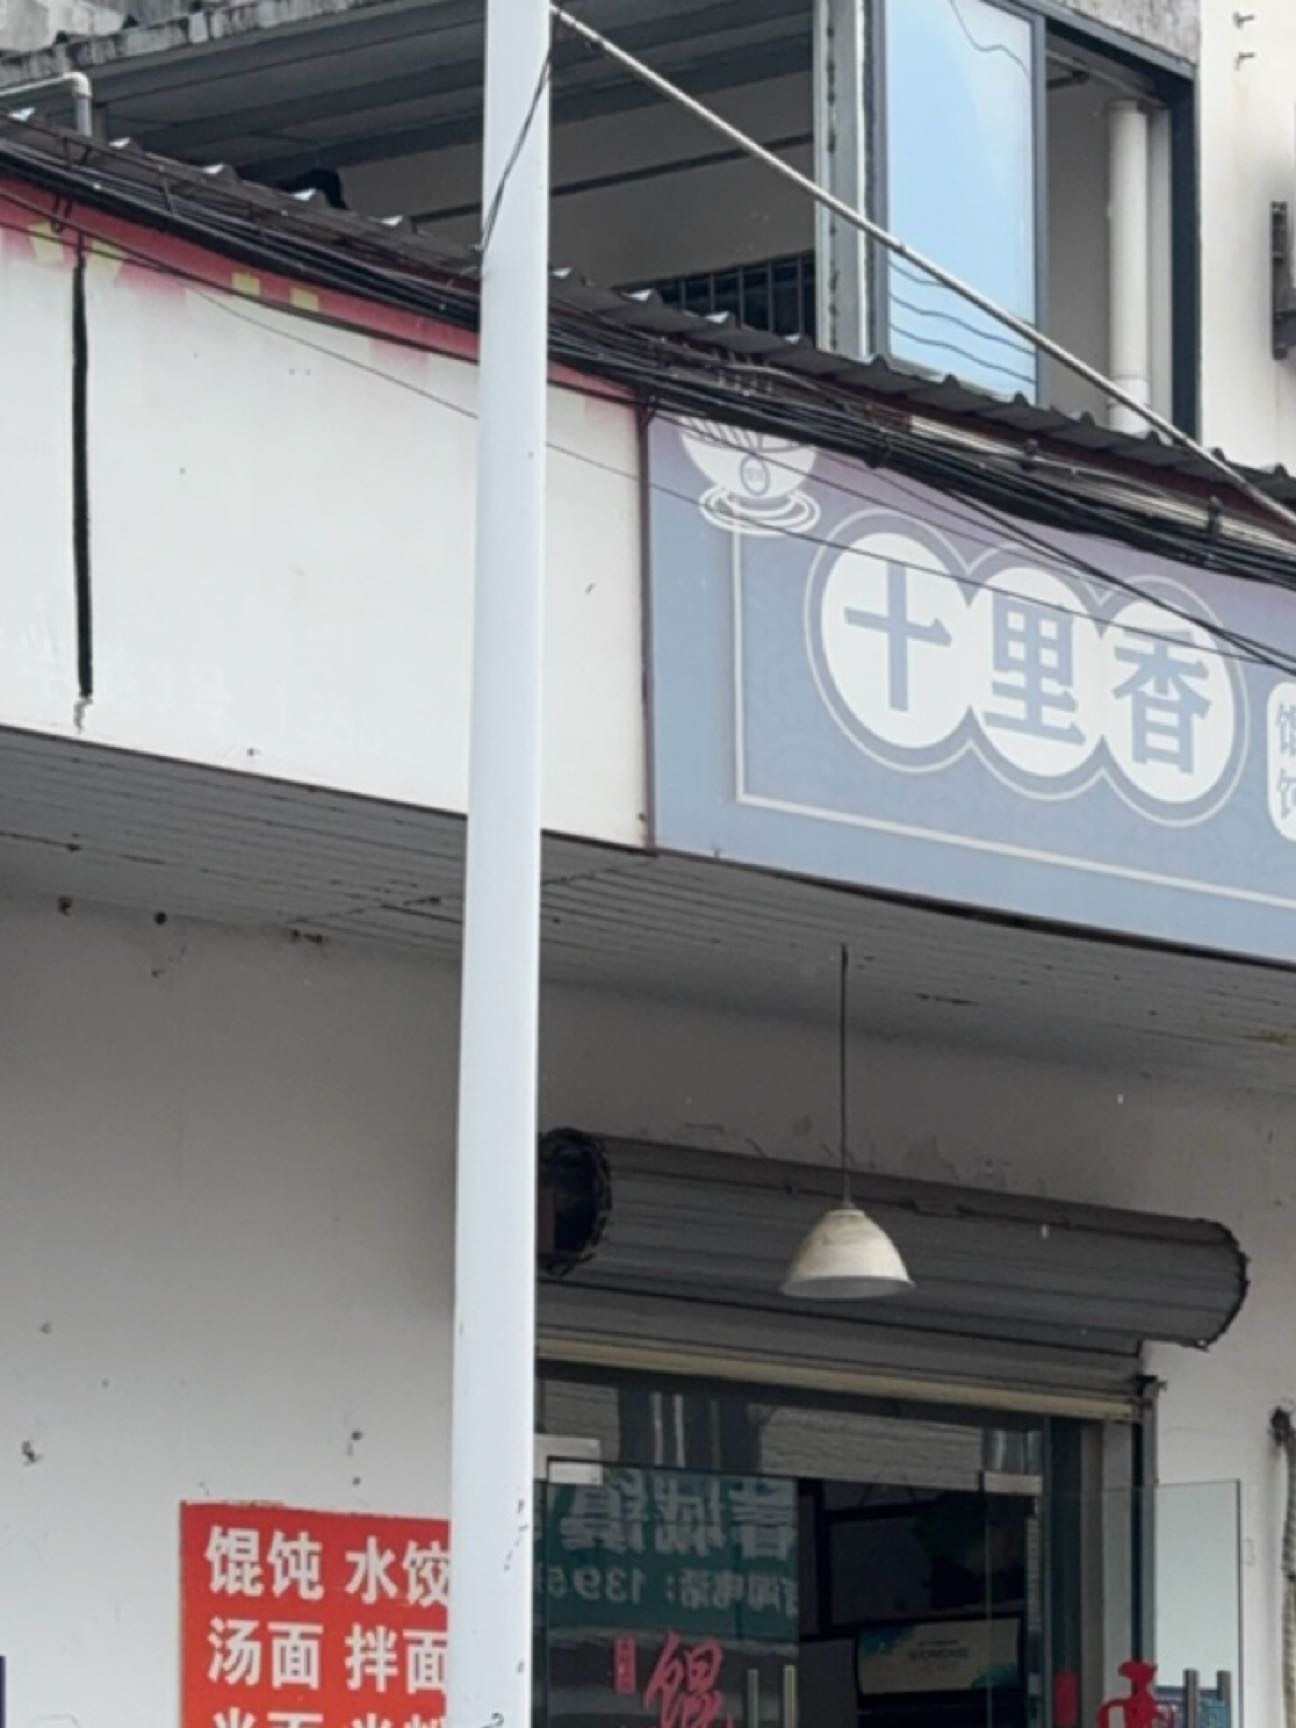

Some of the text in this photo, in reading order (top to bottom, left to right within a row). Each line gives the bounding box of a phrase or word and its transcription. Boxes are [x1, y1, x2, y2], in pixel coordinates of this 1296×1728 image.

[844, 560, 1212, 775] 十里香
[205, 1525, 449, 1609] 馄饨 水饺
[206, 1616, 448, 1694] 汤面 拌面
